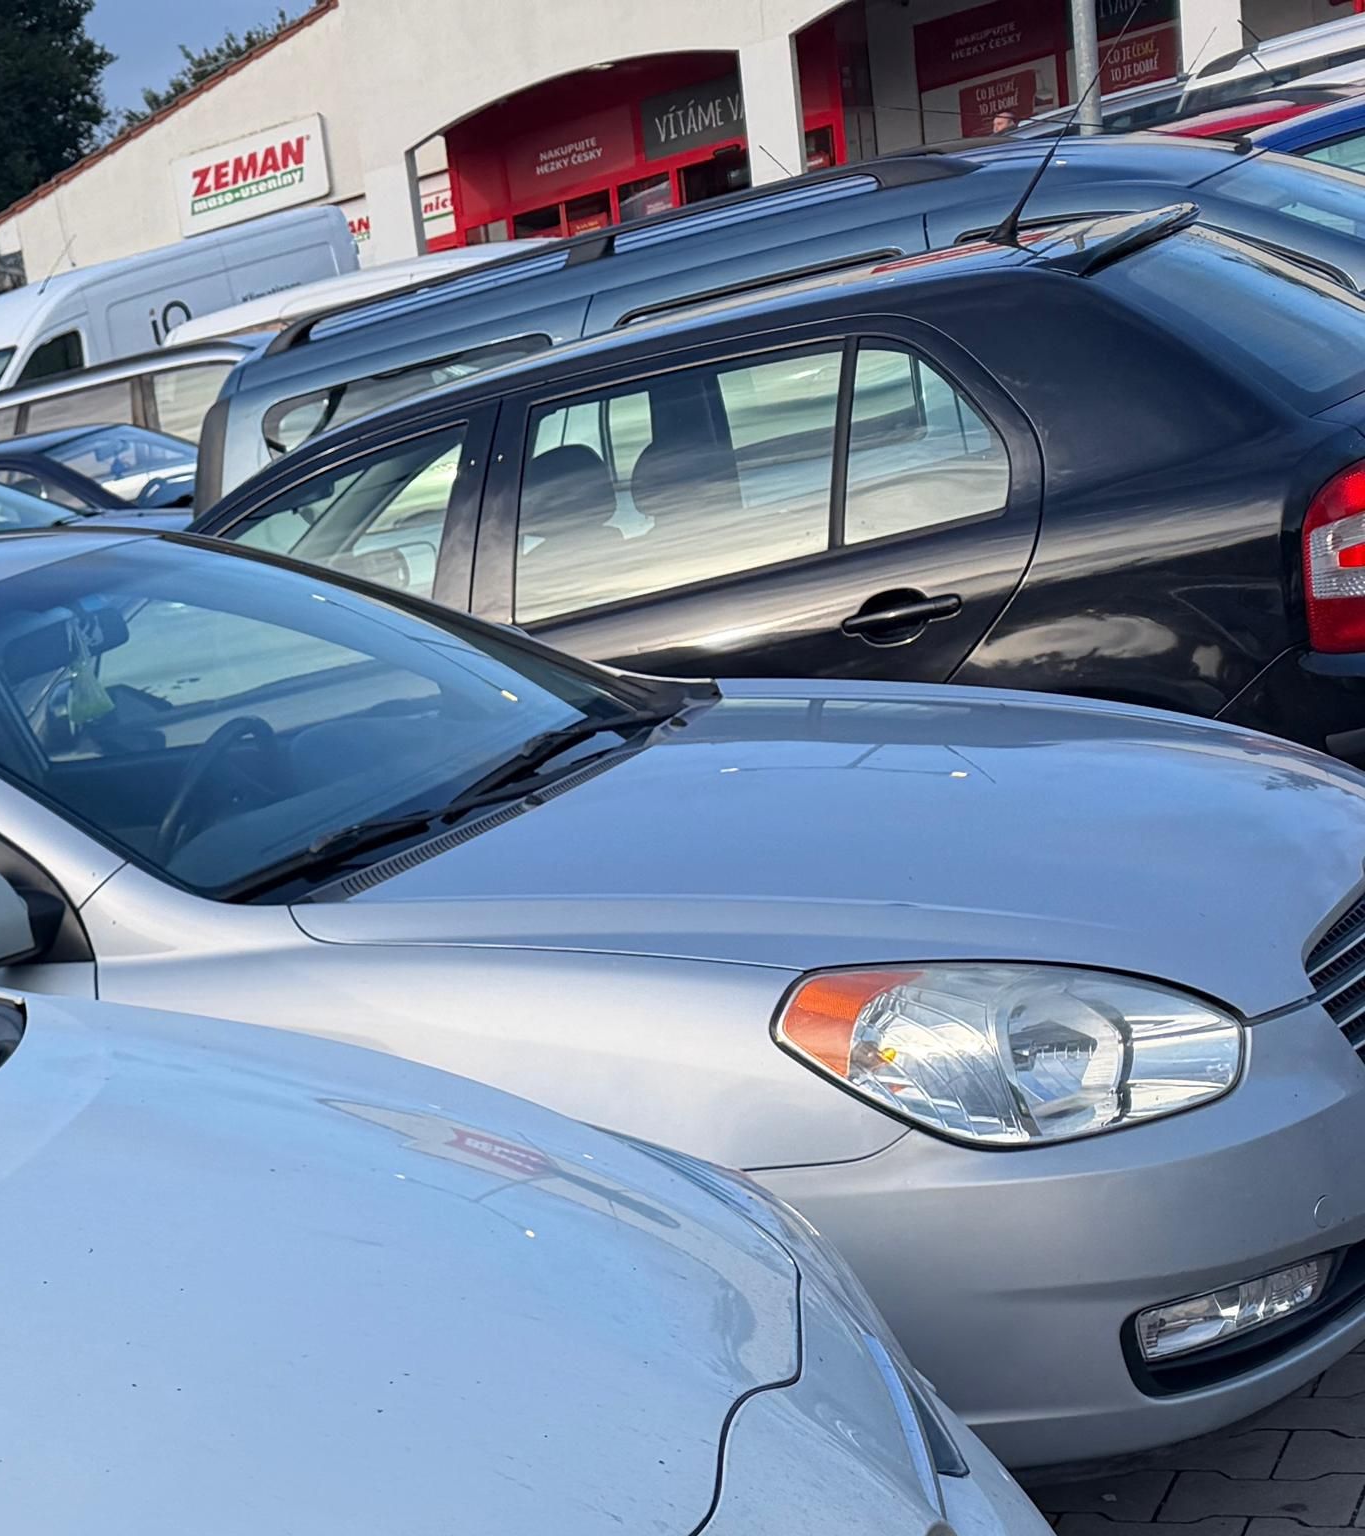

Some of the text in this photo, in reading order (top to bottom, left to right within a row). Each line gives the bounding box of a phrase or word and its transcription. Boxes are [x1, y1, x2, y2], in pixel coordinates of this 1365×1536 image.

[654, 98, 725, 143] VÍTÁME
[192, 136, 304, 197] ZEMAN
[535, 147, 603, 176] HEZKY ČESKY
[539, 136, 597, 162] NAKUPUJTE
